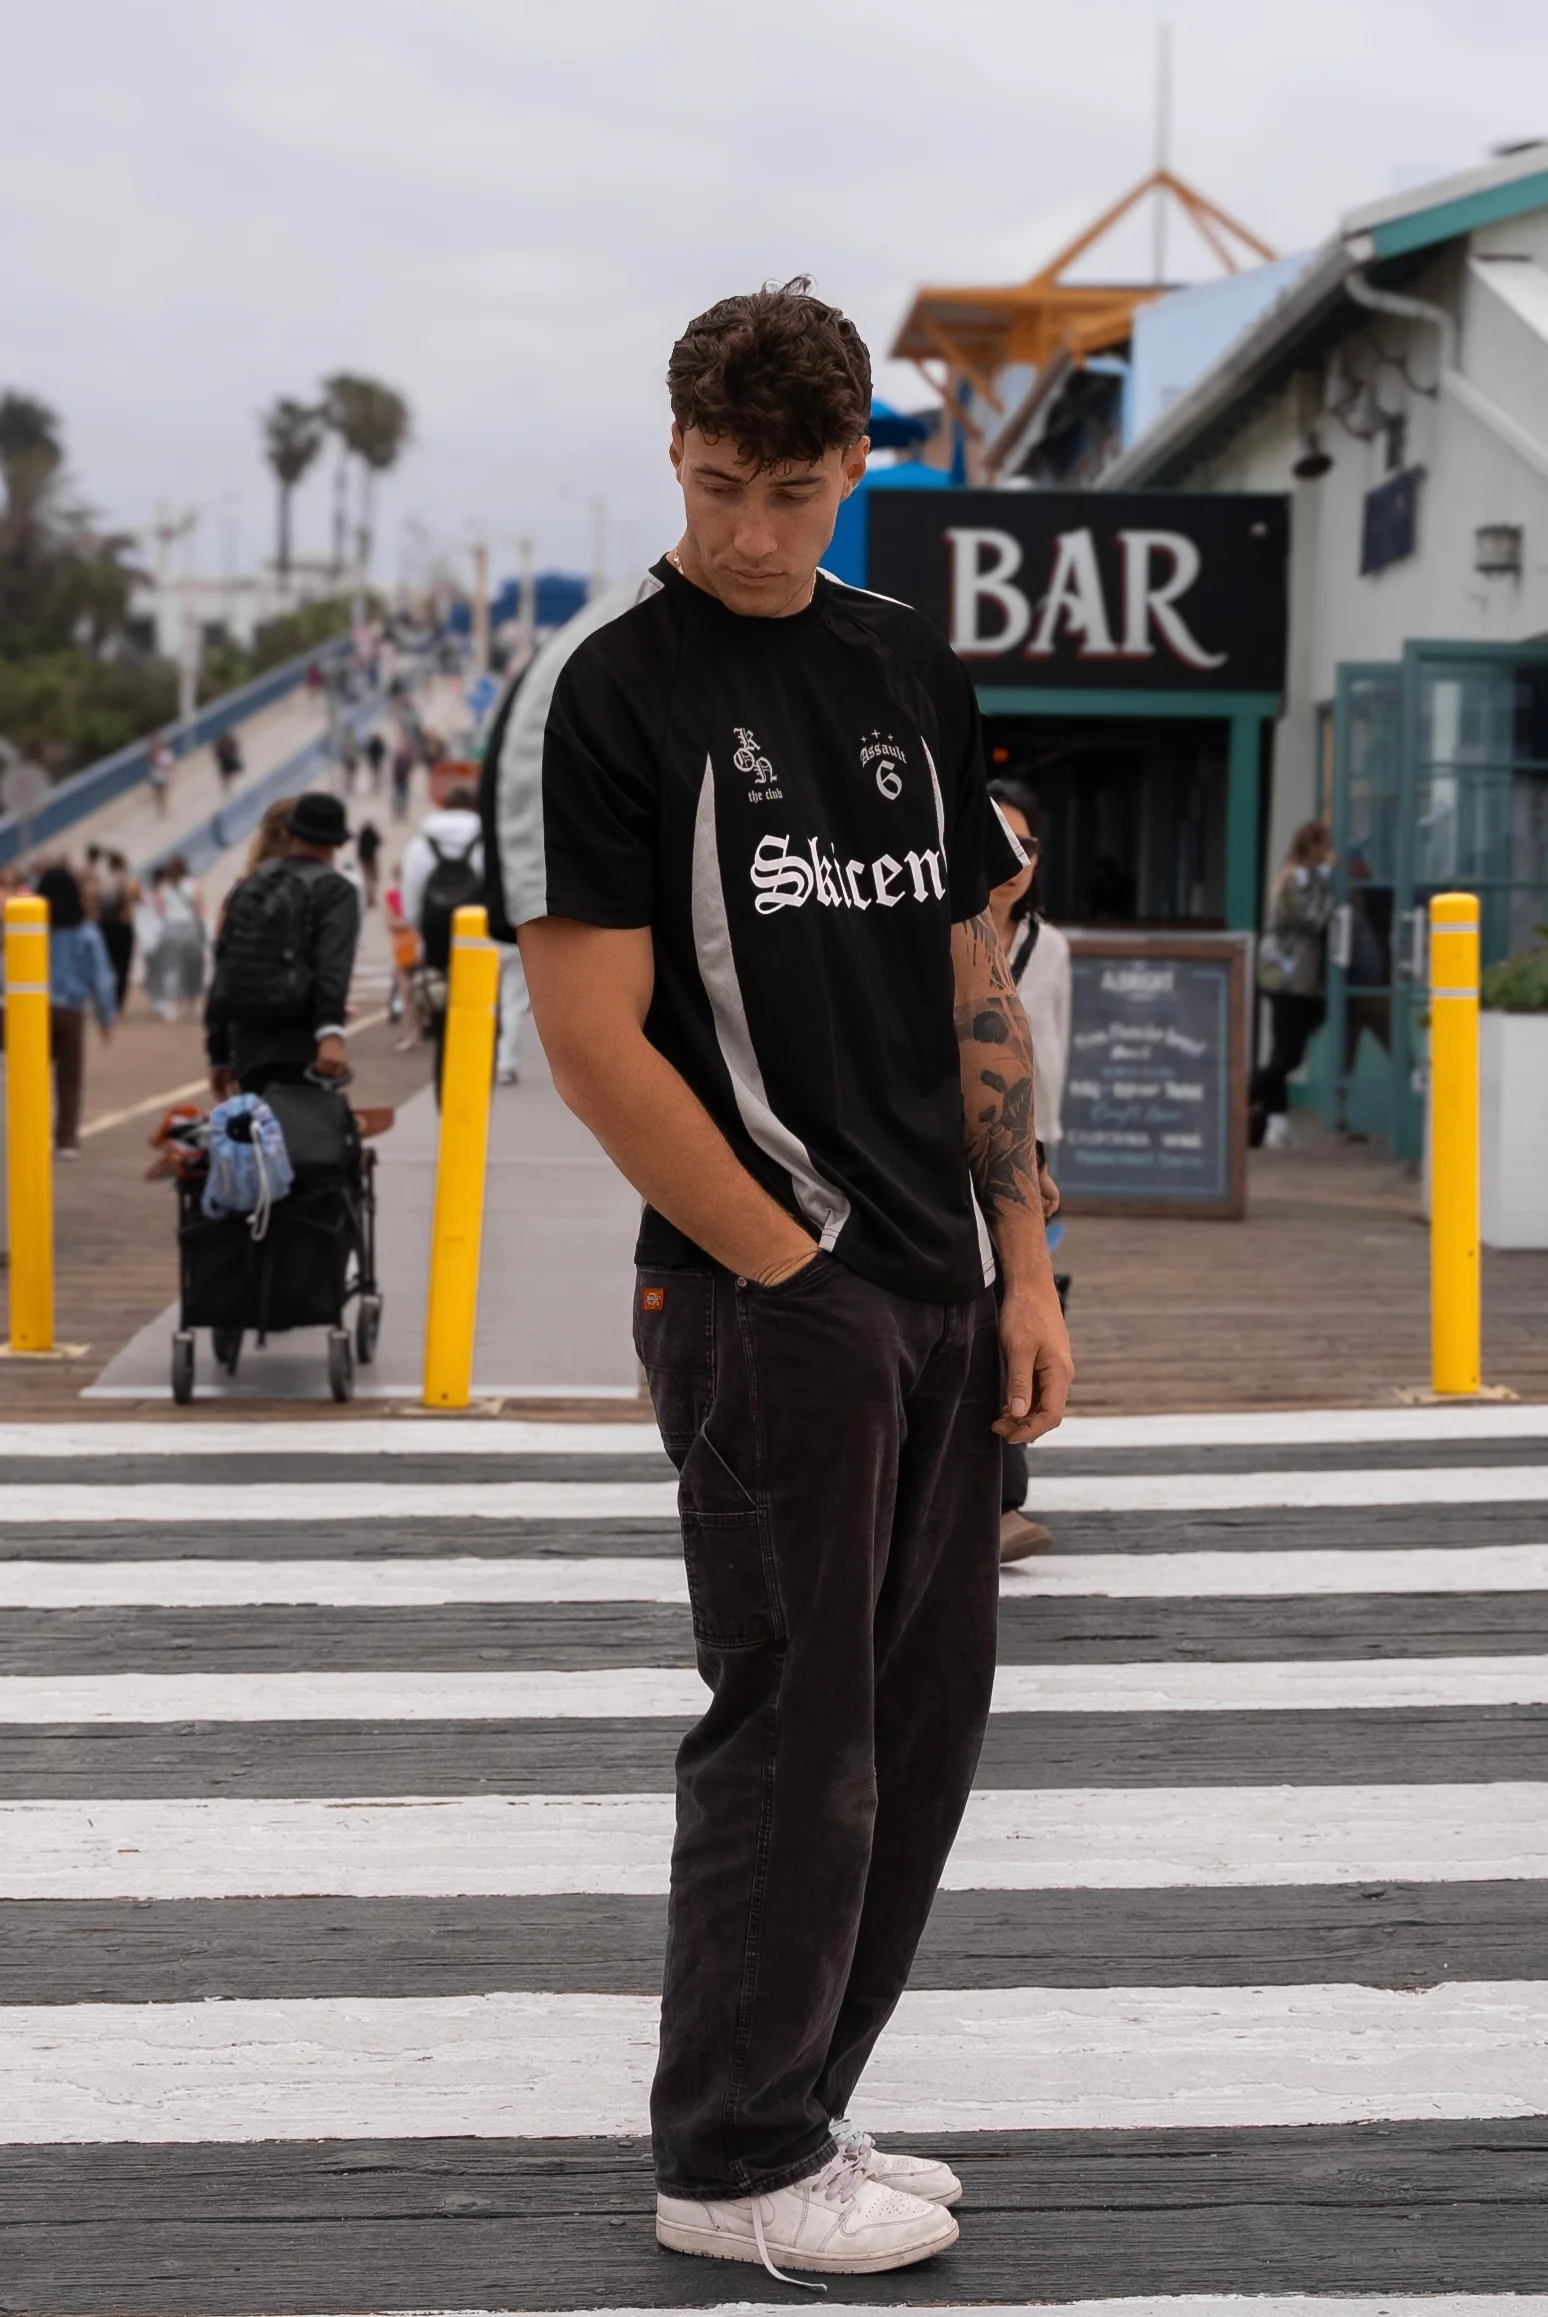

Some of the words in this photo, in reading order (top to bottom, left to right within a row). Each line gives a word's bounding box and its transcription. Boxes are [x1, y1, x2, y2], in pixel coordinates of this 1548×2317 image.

[944, 526, 1229, 671] BAR
[860, 743, 907, 767] Assault
[748, 790, 763, 804] the
[765, 787, 783, 800] club
[876, 760, 903, 800] 6
